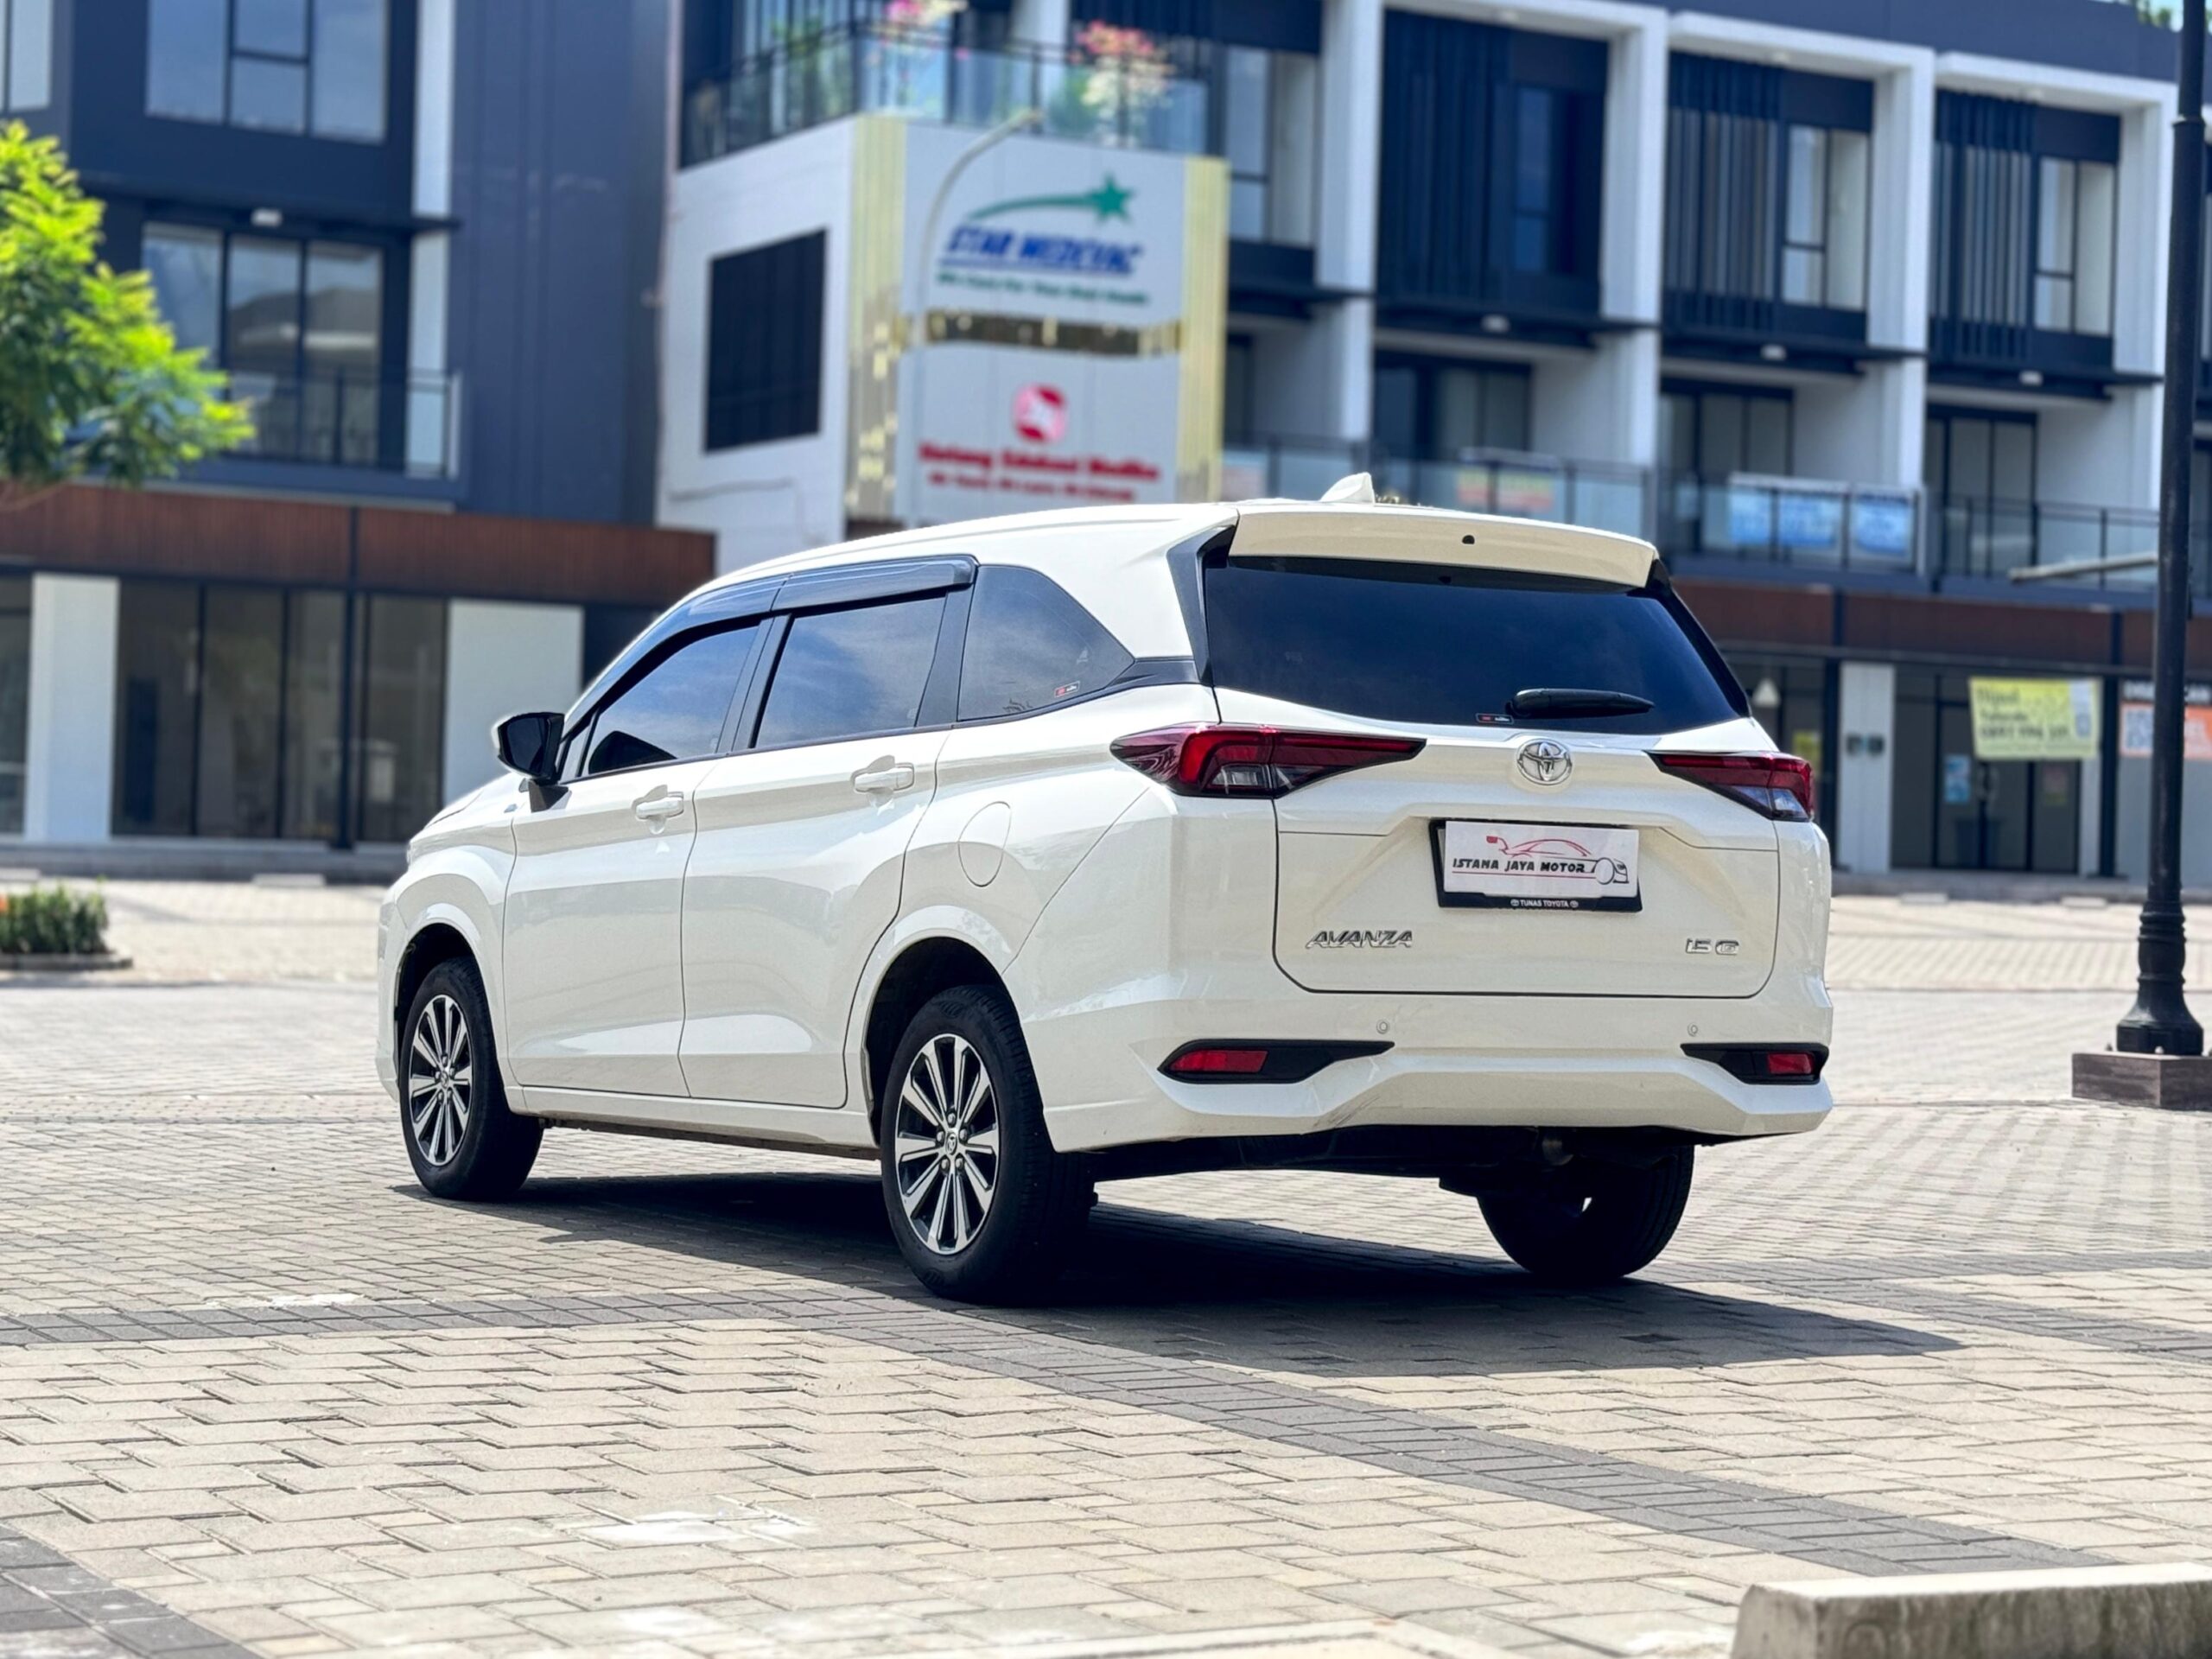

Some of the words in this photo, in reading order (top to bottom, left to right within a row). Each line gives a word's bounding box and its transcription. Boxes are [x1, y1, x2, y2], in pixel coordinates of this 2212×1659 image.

[1452, 857, 1499, 870] ISTANA
[1504, 860, 1535, 872] JAYA
[1540, 861, 1586, 874] MOTOR
[1542, 899, 1569, 908] TOYOTA
[1305, 930, 1413, 950] AVANZA
